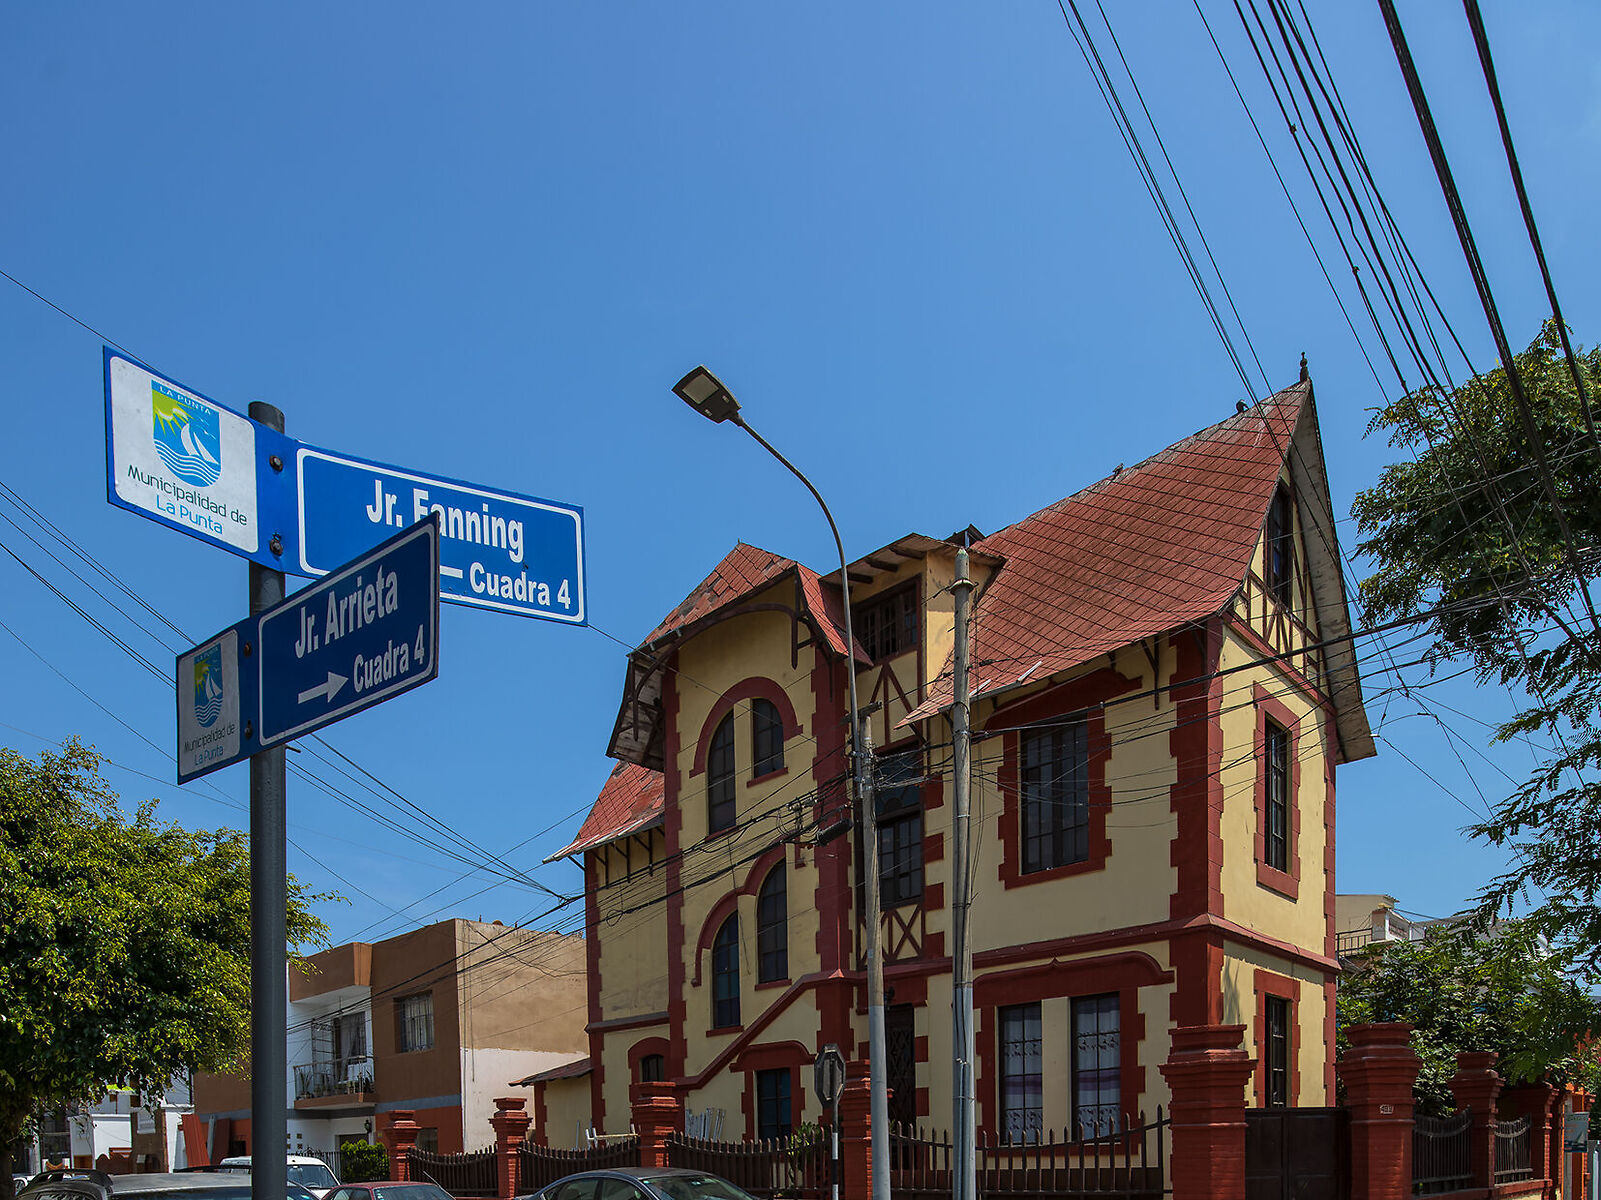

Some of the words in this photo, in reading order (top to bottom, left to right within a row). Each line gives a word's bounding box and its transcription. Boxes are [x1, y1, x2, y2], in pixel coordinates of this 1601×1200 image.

[159, 385, 174, 397] LA
[177, 394, 212, 415] PUNTA
[127, 464, 227, 517] Municipalidad
[230, 508, 248, 526] de
[156, 494, 176, 515] La
[179, 504, 223, 535] Punta
[366, 479, 403, 528] Jr.
[413, 487, 524, 563] Fanning
[469, 561, 551, 606] Cuadra
[557, 579, 571, 610] 4
[295, 606, 319, 659] Jr.
[324, 564, 399, 646] Arrieta
[353, 639, 409, 693] Cuadra
[413, 623, 425, 665] 4
[184, 725, 225, 753] Municipalidad
[226, 722, 235, 736] de
[194, 752, 204, 766] La
[203, 744, 224, 761] Punta
